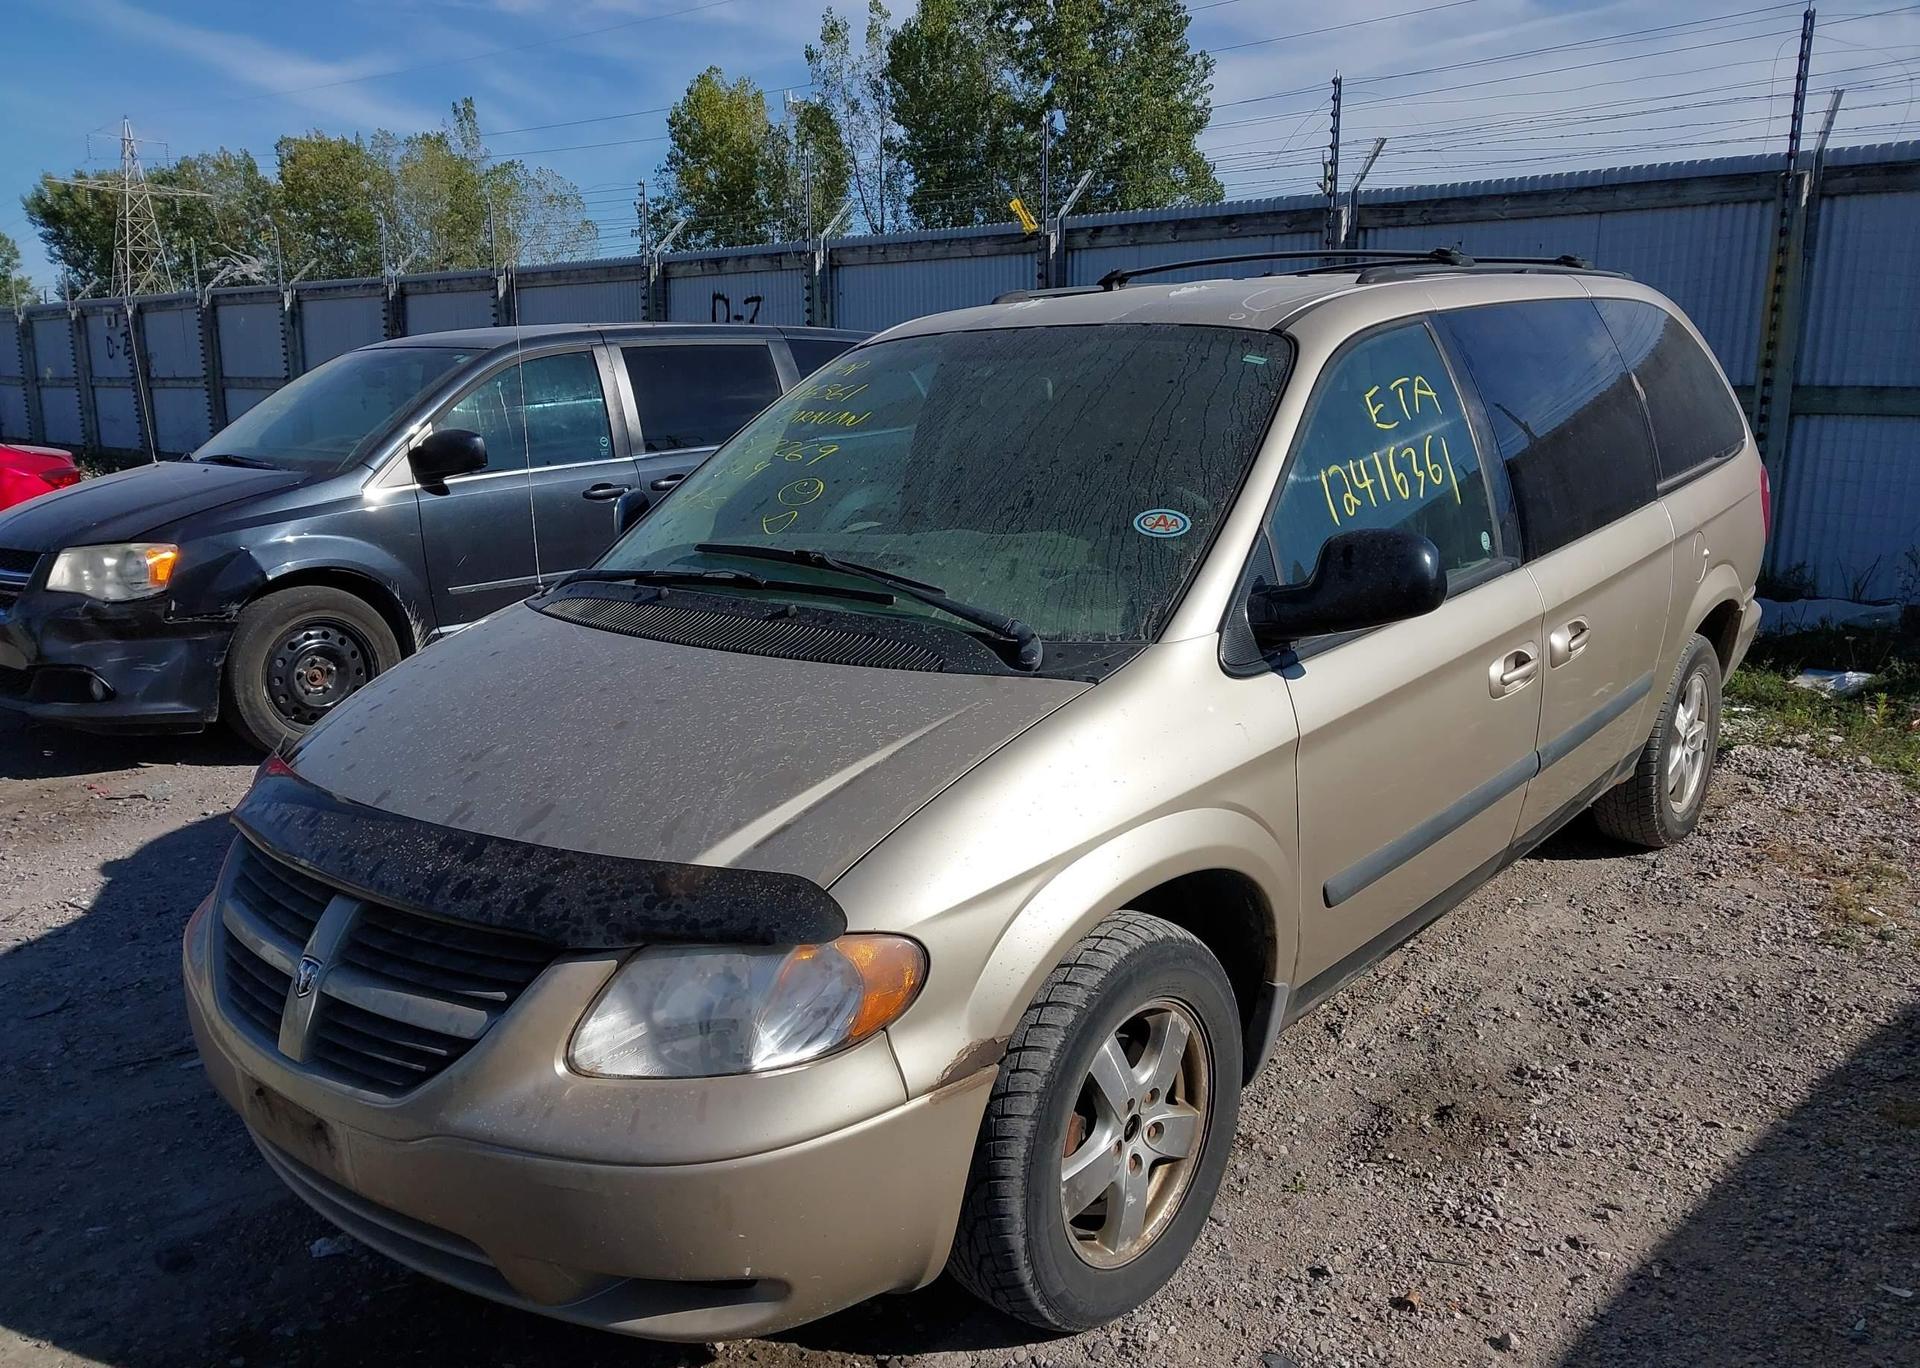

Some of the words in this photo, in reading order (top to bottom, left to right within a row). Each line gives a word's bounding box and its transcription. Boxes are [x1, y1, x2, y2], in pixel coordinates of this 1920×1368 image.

[1365, 375, 1443, 430] ETA
[1320, 434, 1462, 527] 12416361
[1142, 514, 1180, 532] CAA
